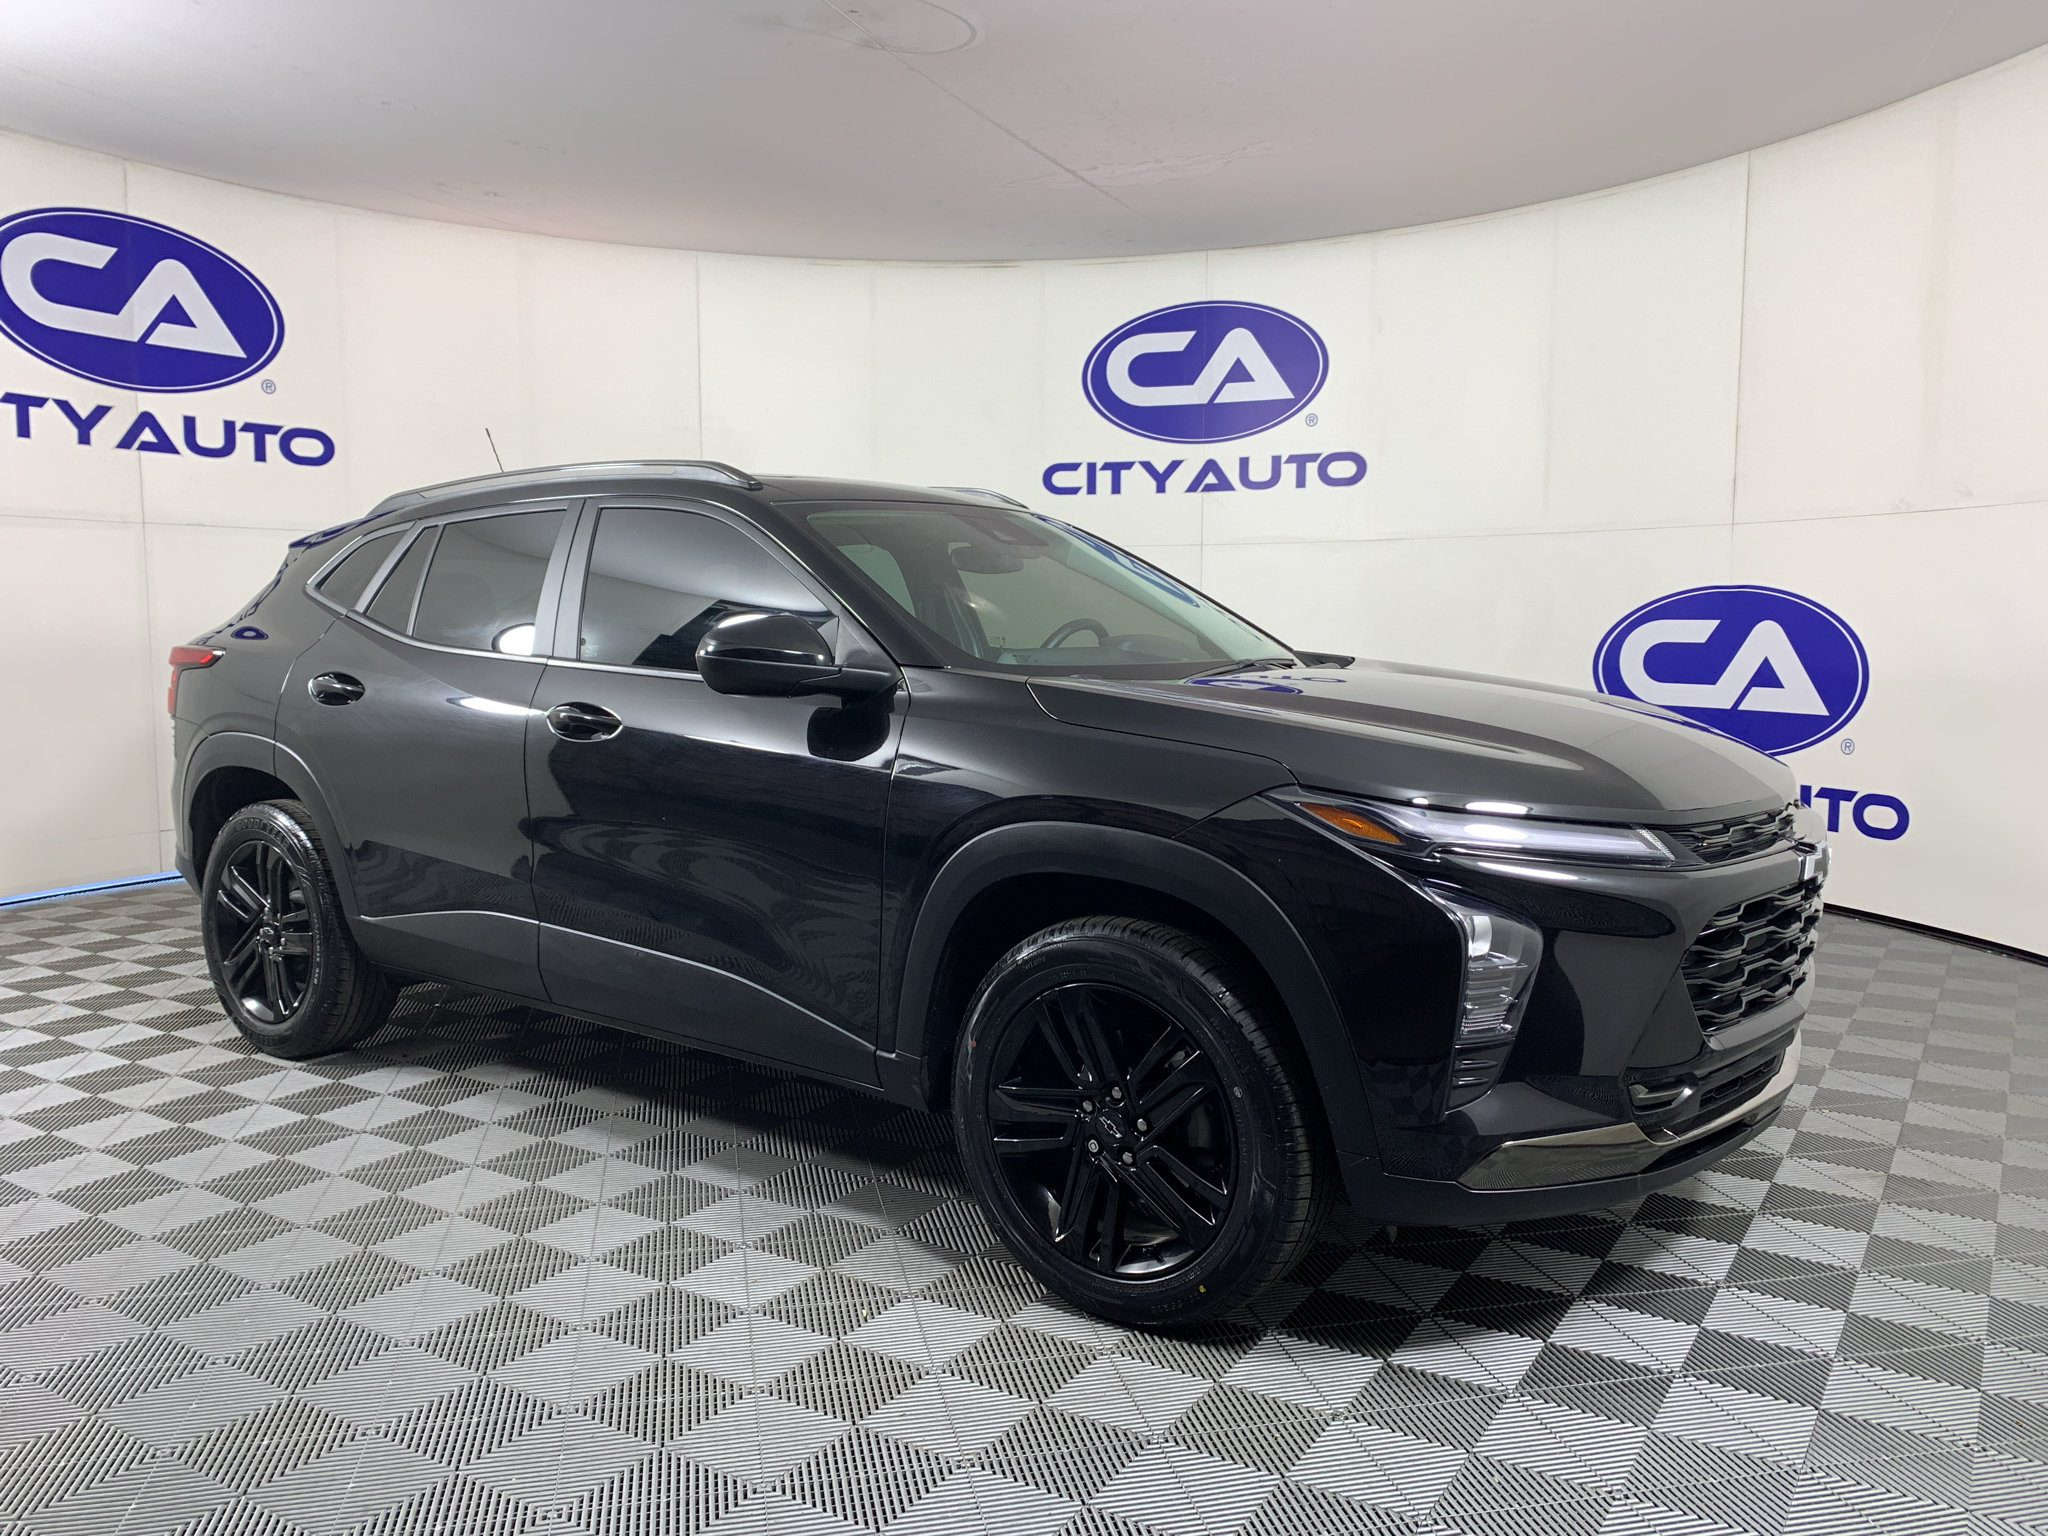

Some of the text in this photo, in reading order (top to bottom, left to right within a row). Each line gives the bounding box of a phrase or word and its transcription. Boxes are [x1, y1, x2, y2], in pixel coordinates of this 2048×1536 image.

[0, 231, 248, 359] CA
[1105, 327, 1296, 407] CA
[1618, 619, 1830, 716] CA
